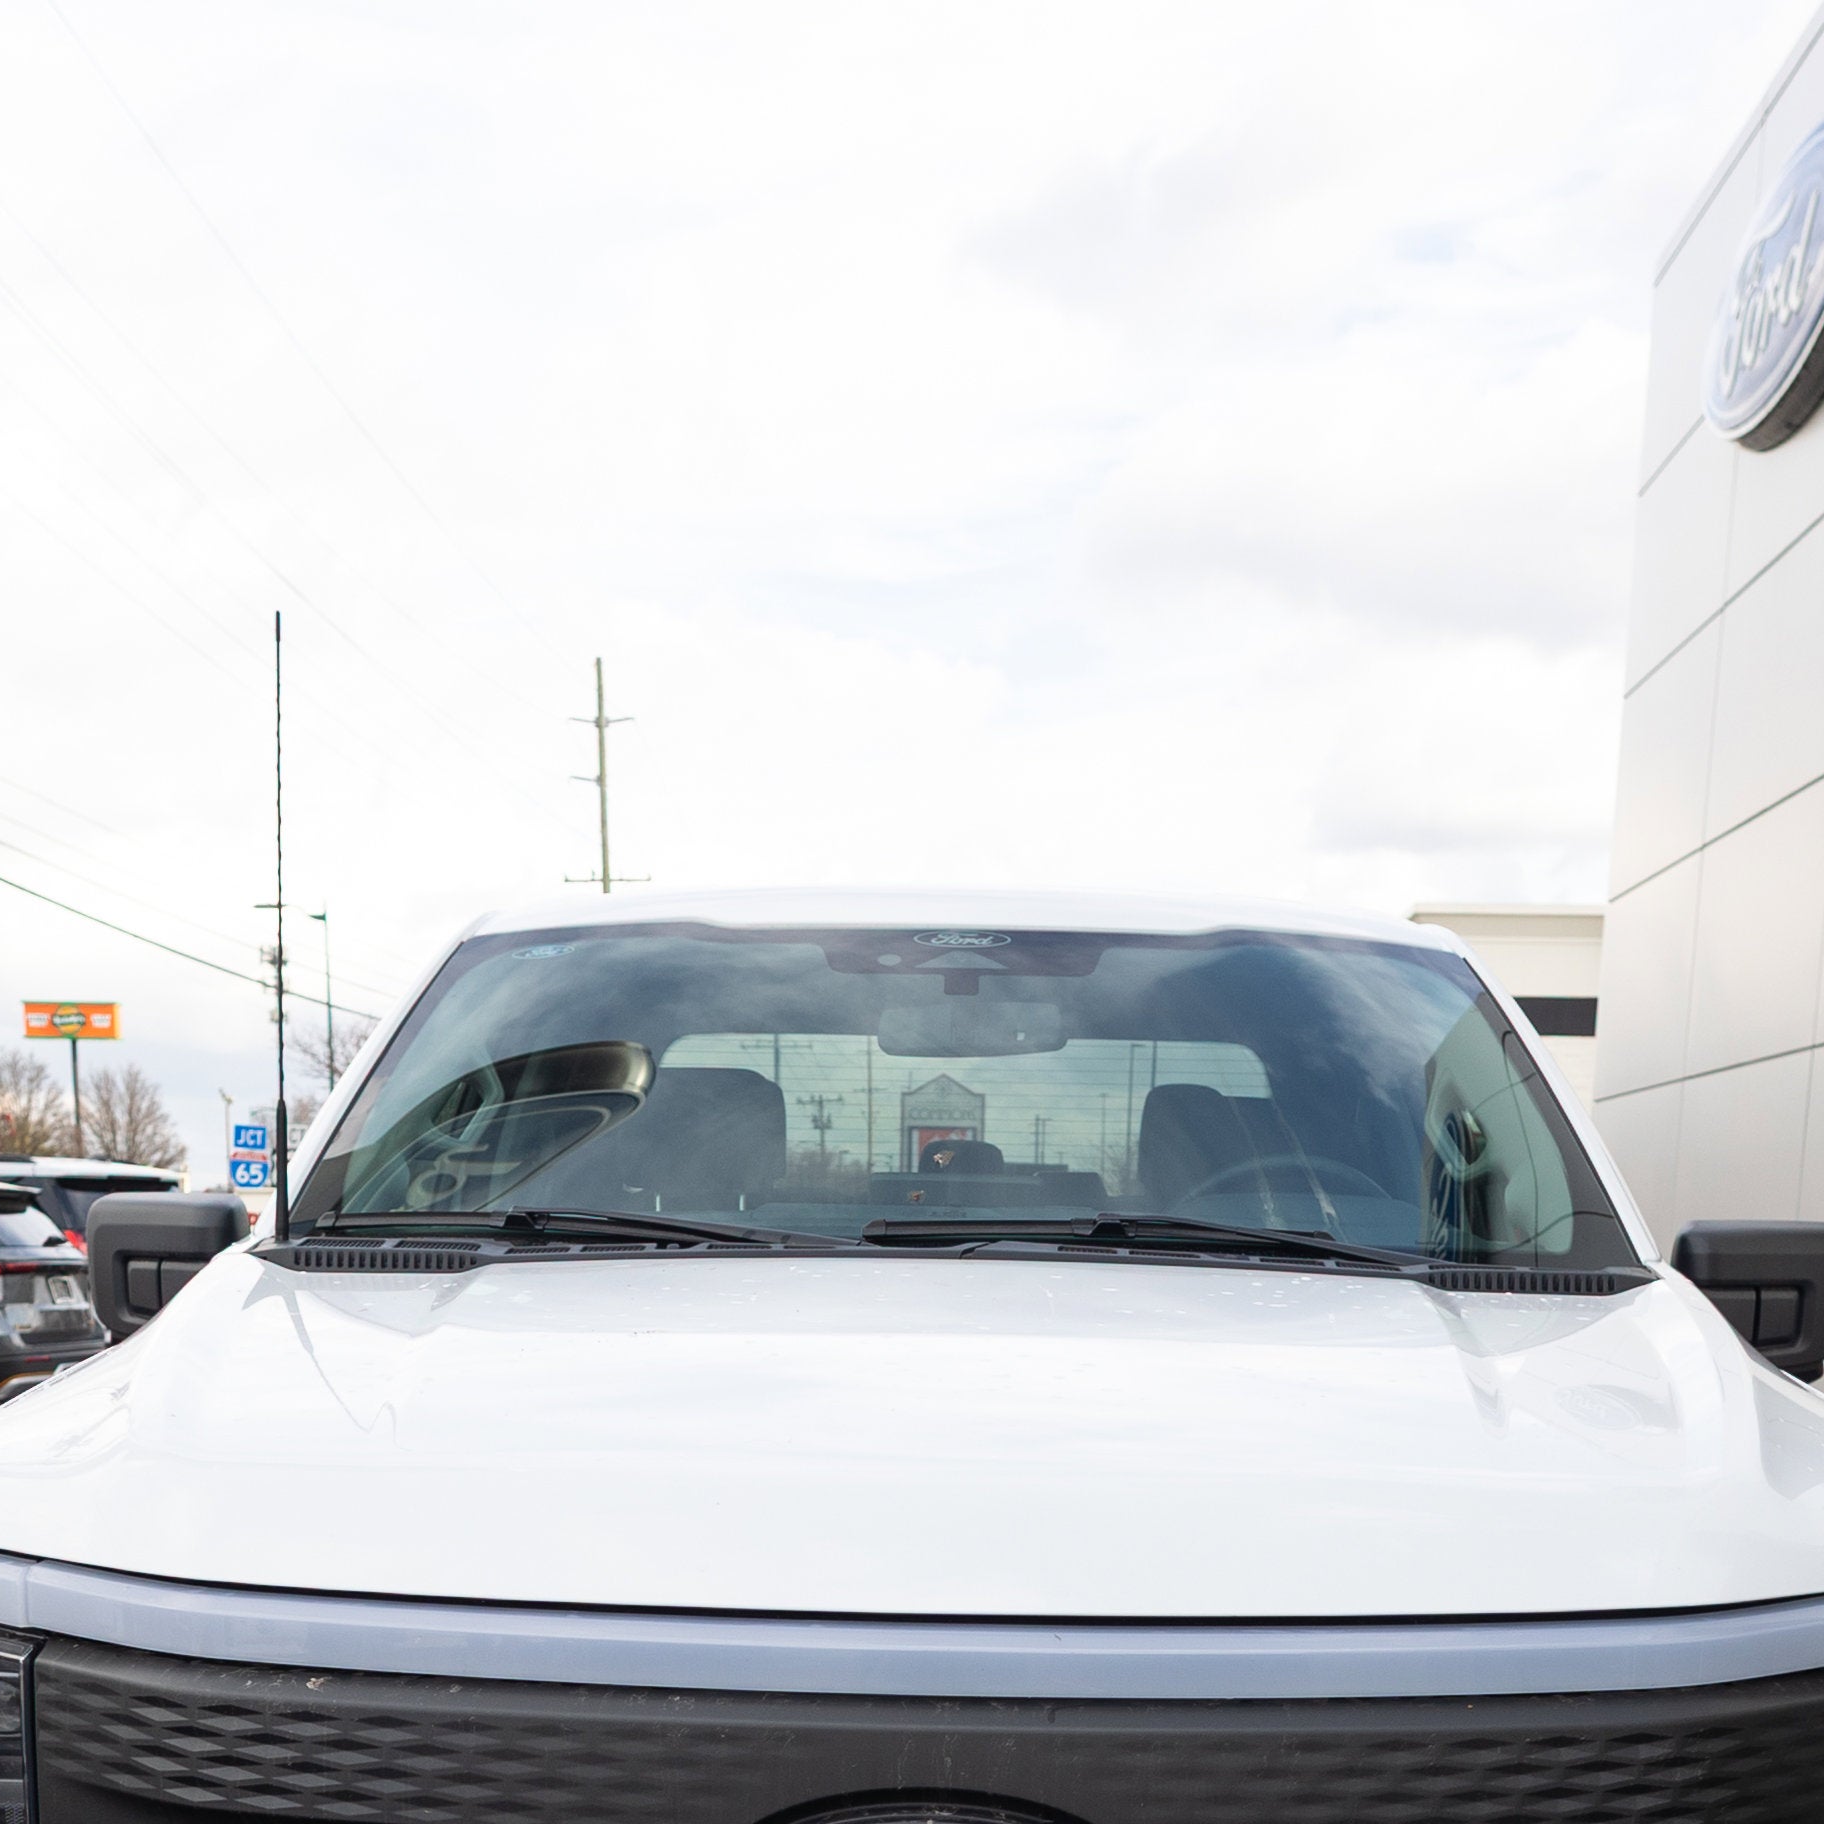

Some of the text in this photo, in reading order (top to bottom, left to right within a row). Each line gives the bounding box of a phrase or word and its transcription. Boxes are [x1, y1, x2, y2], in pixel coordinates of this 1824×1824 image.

[1721, 189, 1819, 397] Ford
[931, 931, 994, 945] Ford
[237, 1129, 264, 1146] JCT
[236, 1163, 264, 1185] 65
